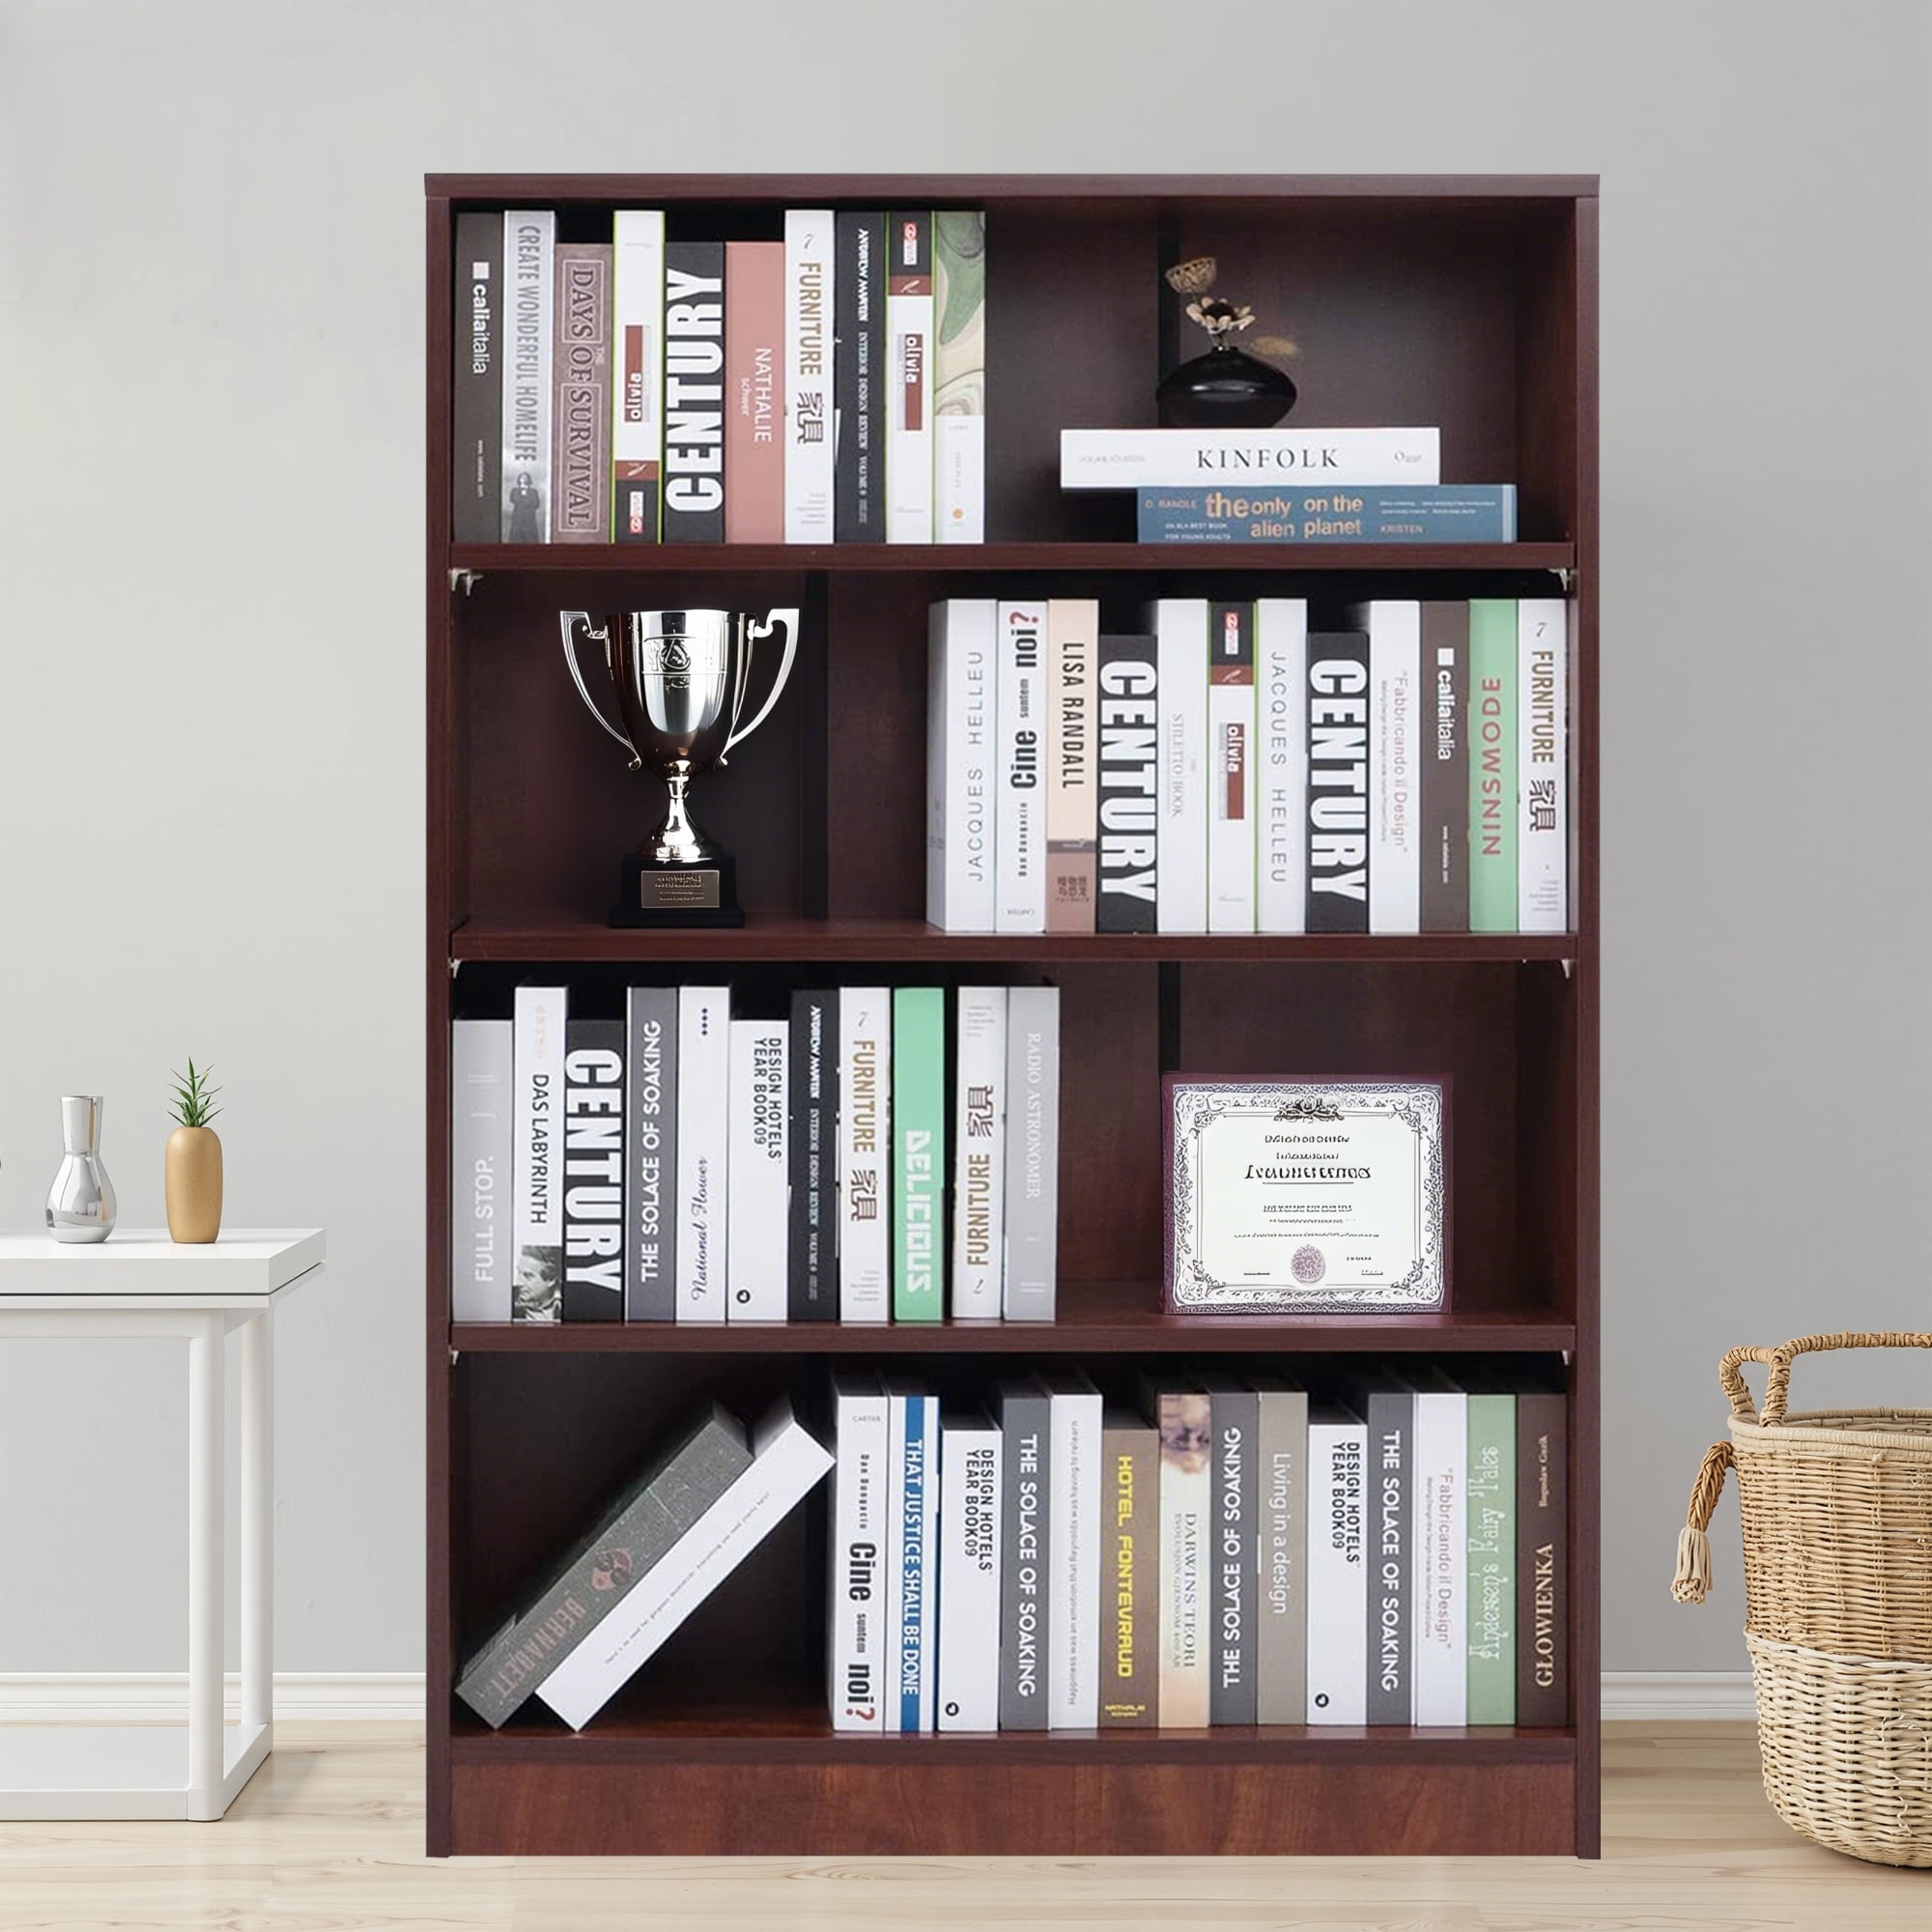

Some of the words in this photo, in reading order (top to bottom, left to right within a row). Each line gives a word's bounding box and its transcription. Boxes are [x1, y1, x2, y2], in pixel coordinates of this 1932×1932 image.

[518, 225, 541, 279] CREATE
[472, 285, 491, 374] caliaitalia
[517, 286, 540, 380] WONDERFUL
[572, 269, 594, 339] DAYS
[799, 262, 822, 376] FURNITURE
[570, 347, 593, 382] OF
[666, 268, 724, 512] CENTURY
[905, 336, 922, 384] olivia
[515, 386, 538, 462] HOMELIFE
[625, 372, 641, 420] olivia
[753, 348, 772, 442] NATHALIE
[568, 387, 593, 526] SURVIVAL
[1197, 448, 1339, 469] KINFOLK
[1206, 492, 1249, 519] the
[1251, 496, 1292, 519] only
[1304, 498, 1328, 513] on
[1332, 495, 1363, 513] the
[1250, 520, 1294, 538] alien
[1304, 517, 1362, 539] planet
[1009, 611, 1039, 668] noi?
[1063, 642, 1085, 688] LISA
[968, 651, 983, 745] HELLEU
[1019, 678, 1030, 718] suntem
[1271, 651, 1287, 766] JACQUES
[1437, 670, 1455, 760] caliaitalia
[1531, 650, 1555, 764] FURNITURE
[1010, 730, 1037, 788] Cine
[1063, 697, 1085, 789] RANDALL
[1228, 725, 1244, 773] olivia
[1482, 678, 1501, 855] NINSMODE
[1100, 661, 1157, 902] CENTURY
[1310, 660, 1367, 902] CENTURY
[968, 768, 983, 882] JACQUES
[1271, 790, 1287, 883] HELLEU
[642, 1019, 662, 1117] SOAKING
[754, 1037, 768, 1078] YEAR
[768, 1037, 782, 1094] DESIGN
[1027, 1032, 1041, 1084] RADIO
[531, 1074, 550, 1111] DAS
[853, 1039, 876, 1153] FURNITURE
[642, 1122, 661, 1151] OF
[1026, 1090, 1041, 1200] ASTRONOMER
[475, 1155, 495, 1220] STOP.
[530, 1118, 549, 1225] LABYRINTH
[565, 1049, 623, 1293] CENTURY
[642, 1156, 661, 1236] SOLACE
[691, 1156, 708, 1215] Flower
[906, 1129, 932, 1293] DELICIOUS
[968, 1153, 990, 1266] FURNITURE
[475, 1226, 495, 1282] FULL
[641, 1242, 659, 1283] THE
[691, 1221, 708, 1301] National
[906, 1439, 923, 1486] THAT
[966, 1449, 980, 1490] YEAR
[980, 1449, 995, 1506] DESIGN
[1020, 1435, 1037, 1474] THE
[1224, 1427, 1242, 1521] SOAKING
[1332, 1442, 1347, 1482] YEAR
[1347, 1442, 1361, 1497] DESIGN
[1382, 1431, 1401, 1469] THE
[1468, 1445, 1500, 1497] Tales
[1119, 1456, 1133, 1526] HOTEL
[1268, 1453, 1291, 1512] Living
[904, 1492, 923, 1565] JUSTICE
[1019, 1481, 1037, 1560] SOLACE
[1224, 1528, 1241, 1556] OF
[1273, 1515, 1291, 1535] in
[1273, 1538, 1286, 1547] a
[1382, 1477, 1400, 1556] SOLACE
[1468, 1507, 1506, 1553] Fairy
[848, 1542, 877, 1602] Cine
[1018, 1567, 1037, 1595] OF
[1183, 1513, 1197, 1605] DARWINS
[1267, 1550, 1292, 1614] design
[1381, 1561, 1400, 1590] OF
[903, 1570, 922, 1623] SHALL
[1118, 1535, 1133, 1677] FONTEVRAUD
[1224, 1562, 1241, 1641] SOLACE
[1468, 1563, 1509, 1660] Andersen's
[857, 1613, 867, 1654] suntem
[903, 1626, 921, 1646] BE
[1018, 1601, 1037, 1697] SOAKING
[1183, 1608, 1196, 1668] TEORI
[1381, 1597, 1400, 1691] SOAKING
[846, 1663, 876, 1721] noi?
[902, 1649, 920, 1695] DONE
[1223, 1648, 1241, 1689] THE
